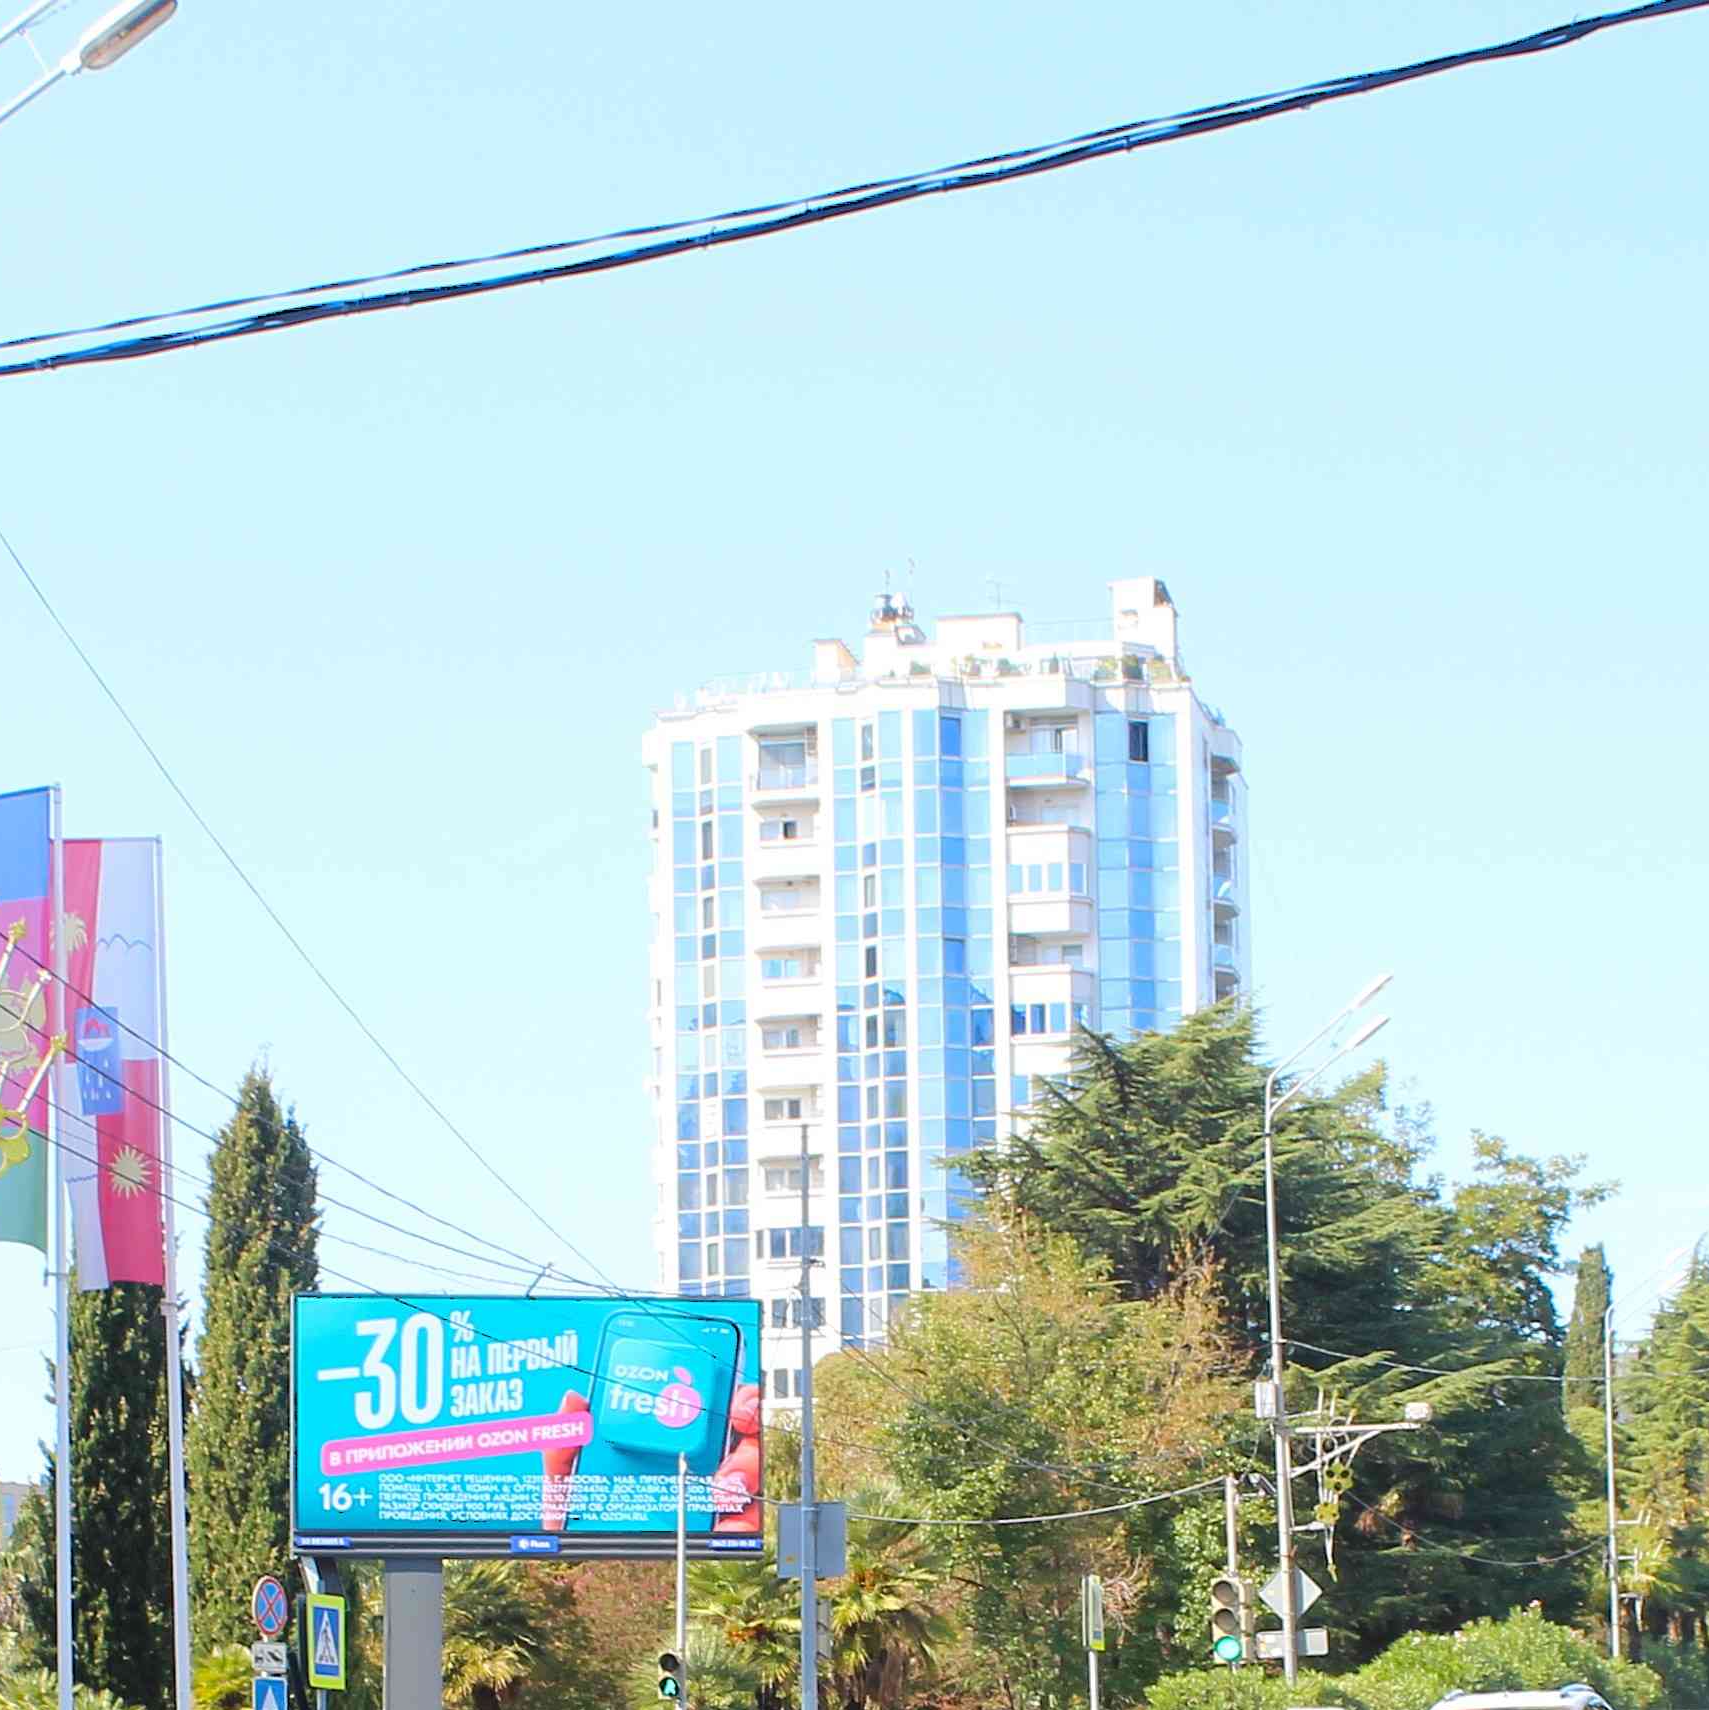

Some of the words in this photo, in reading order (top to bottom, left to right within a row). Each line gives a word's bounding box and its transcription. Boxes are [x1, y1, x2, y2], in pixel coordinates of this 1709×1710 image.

[450, 1345, 482, 1380] НА
[487, 1329, 579, 1375] ПЕРВЫЙ
[450, 1378, 524, 1417] ЗАКАЗ
[609, 1384, 691, 1419] fresh
[328, 1450, 343, 1467] В
[345, 1437, 474, 1465] ПРИЛОЖЕНИИ
[477, 1429, 529, 1451] OZON
[532, 1420, 585, 1446] FRESH
[318, 1482, 374, 1511] 16+
